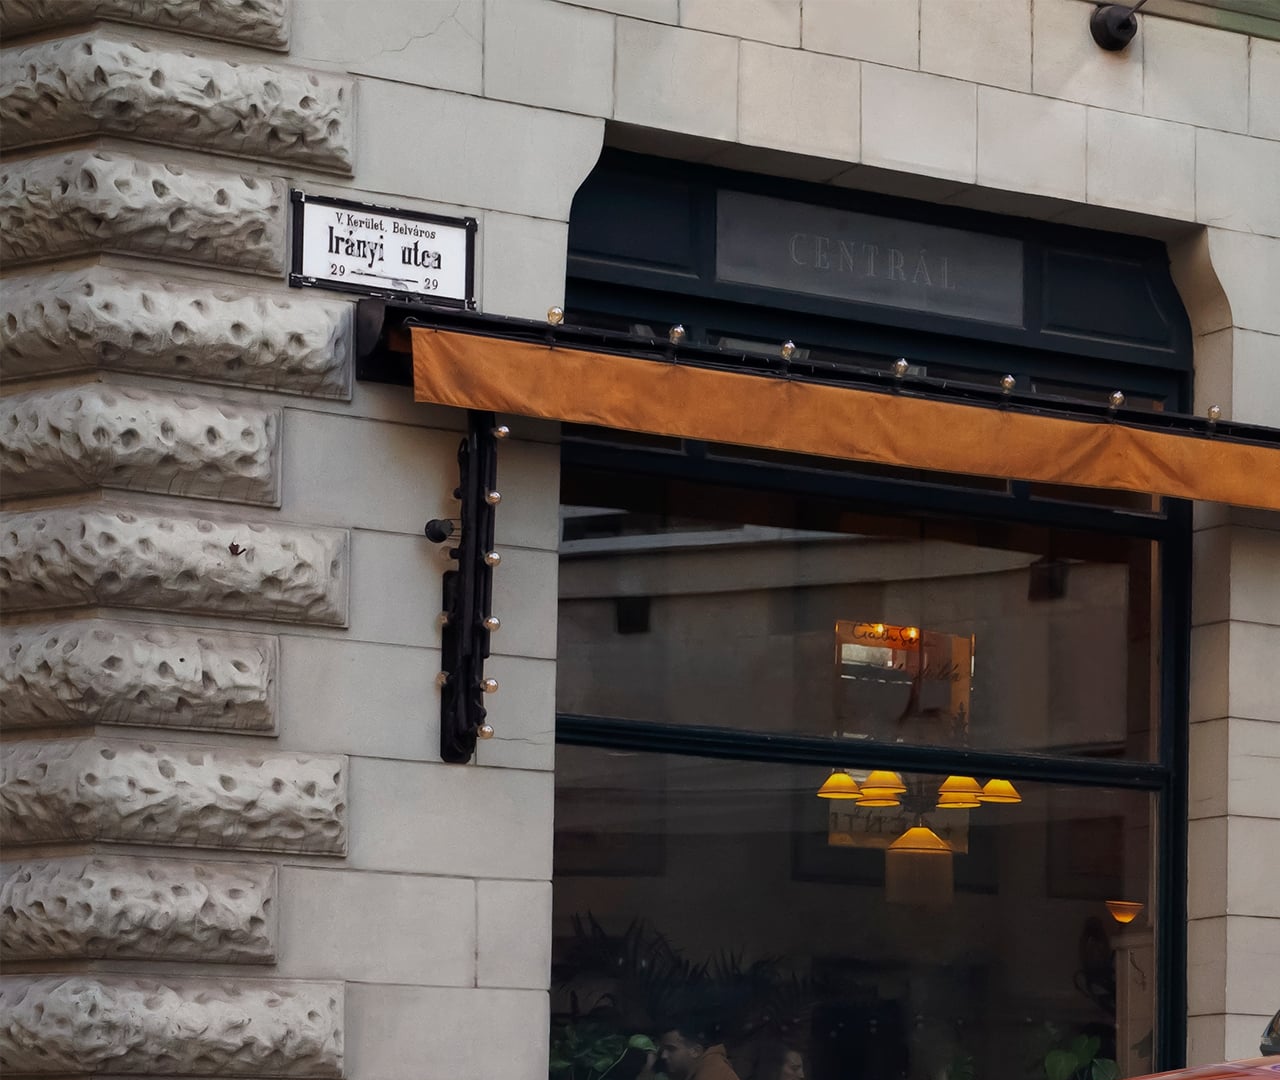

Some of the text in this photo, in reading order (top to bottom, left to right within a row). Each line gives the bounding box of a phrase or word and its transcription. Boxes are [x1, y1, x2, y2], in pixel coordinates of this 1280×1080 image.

[327, 225, 442, 270] Irányi utca
[392, 221, 436, 239] Belváros
[330, 263, 439, 290] 29 29
[788, 233, 957, 291] CENTRÁL
